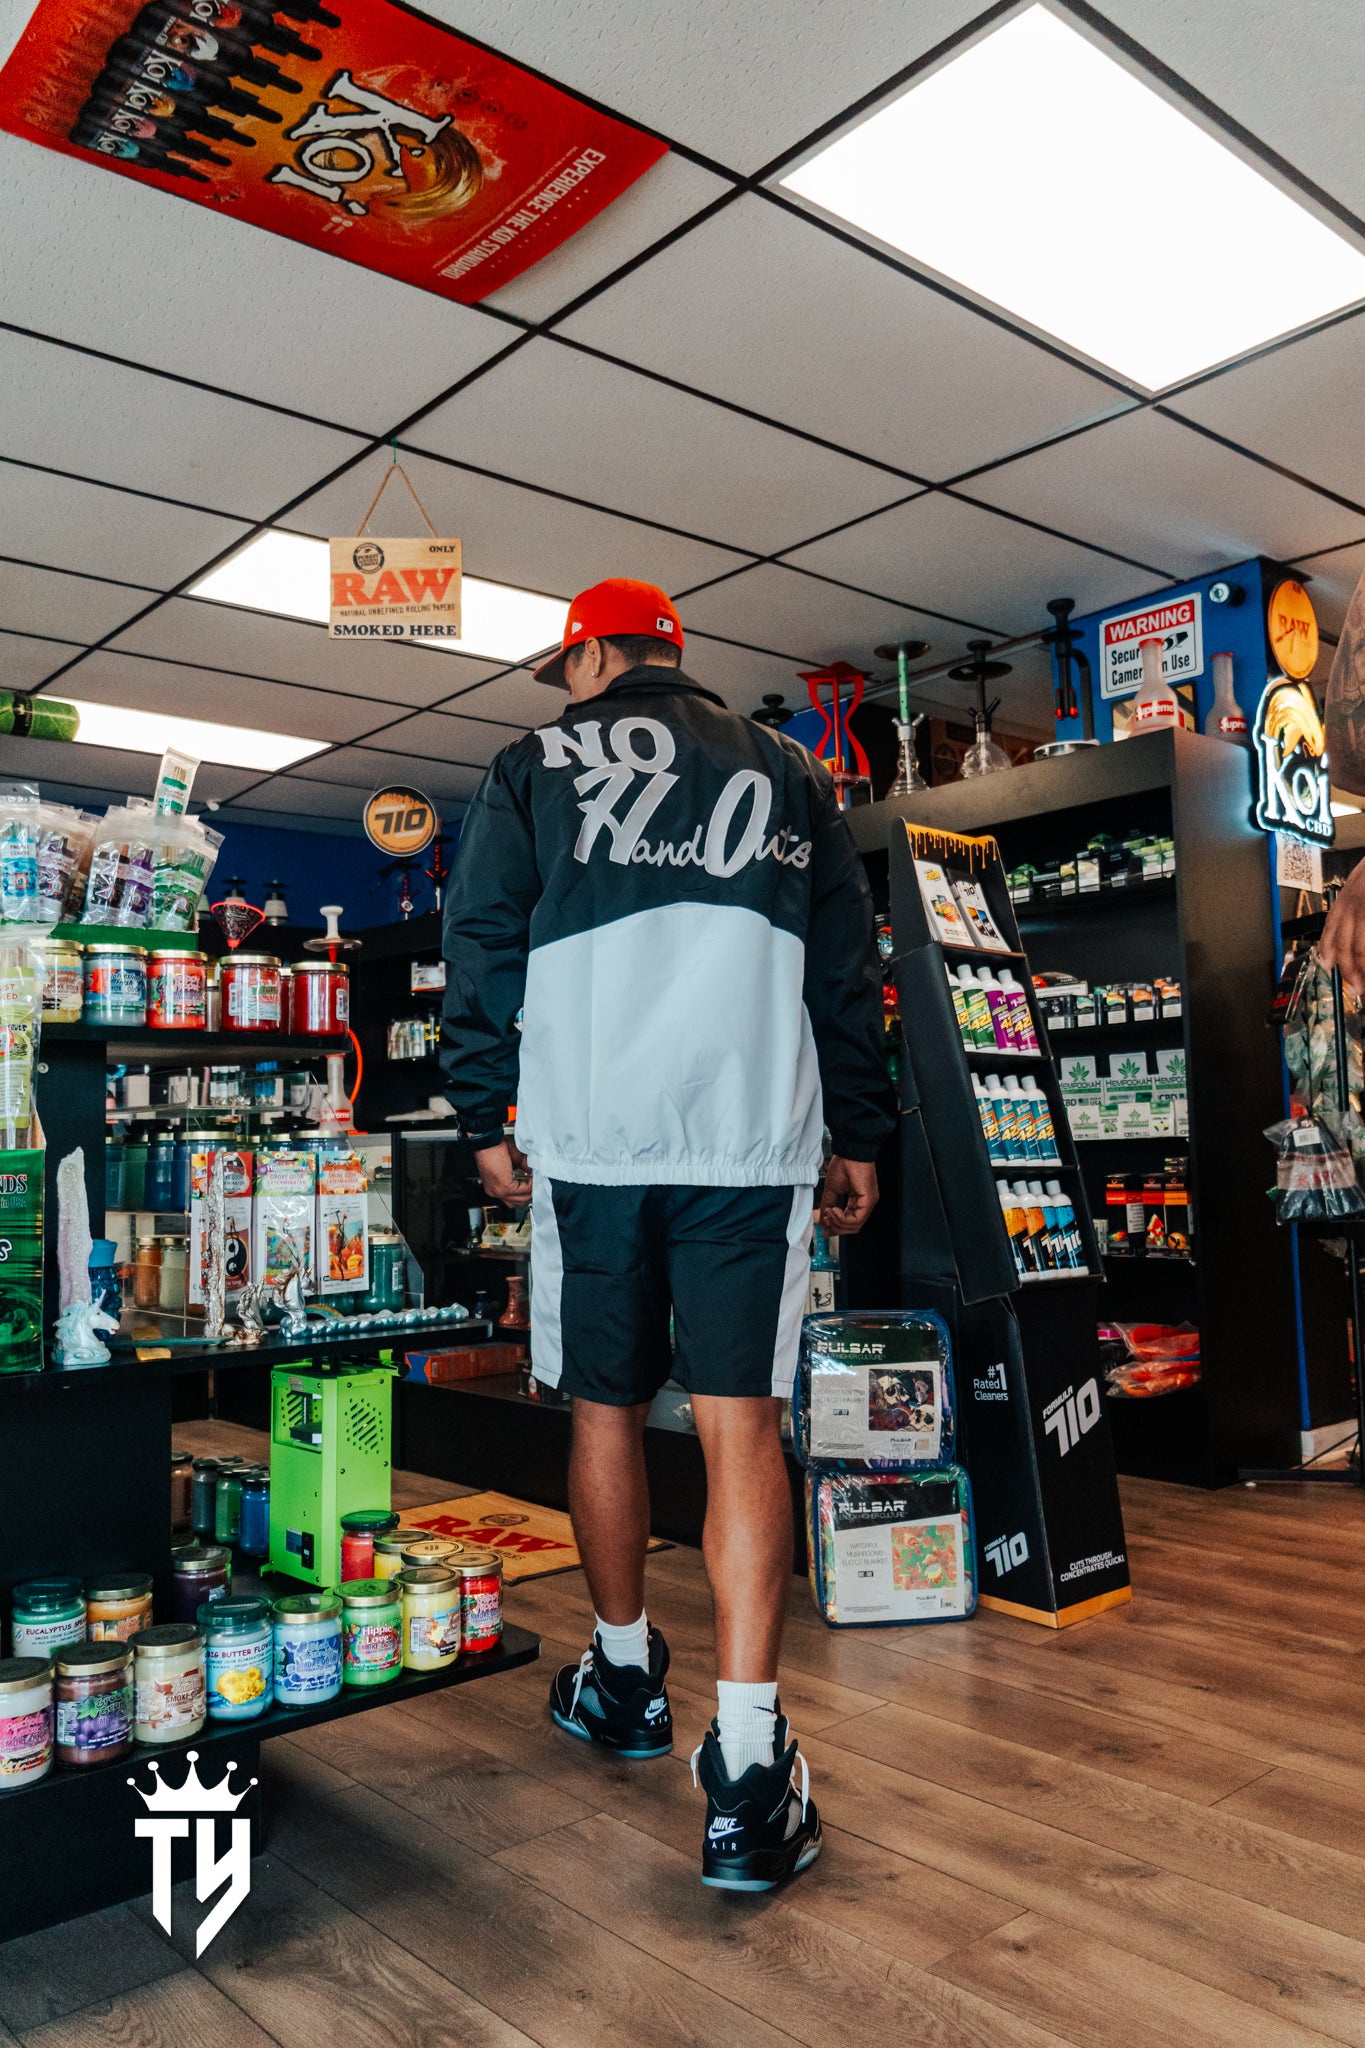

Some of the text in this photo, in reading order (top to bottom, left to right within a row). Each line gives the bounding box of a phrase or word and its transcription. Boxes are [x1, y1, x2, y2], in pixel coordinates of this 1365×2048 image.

[527, 148, 607, 213] EXPERIENCE
[506, 208, 541, 232] THE
[488, 225, 520, 245] KOI
[429, 545, 456, 553] ONLY
[331, 568, 457, 606] RAW
[340, 603, 456, 617] NATURAL UNREFINED ROLLING PAPERS
[333, 624, 457, 636] SMOKED HERE
[1110, 604, 1191, 642] WARNING
[1278, 614, 1310, 641] RAW
[1111, 648, 1140, 667] Secur
[1171, 654, 1190, 670] Use
[1220, 716, 1246, 732] Supre
[535, 717, 676, 774] NO
[1260, 734, 1332, 829] Koi
[375, 808, 428, 835] 710
[1306, 819, 1332, 837] CBD
[816, 1341, 884, 1354] PULSAR
[973, 1379, 1000, 1390] Rated
[974, 1391, 1009, 1401] Cleaners
[1044, 1377, 1101, 1458] 710
[839, 1500, 906, 1513] PULSAR
[409, 1515, 574, 1553] RAW
[985, 1531, 1029, 1578] 710
[1069, 1551, 1112, 1571] CUTS THROUGH
[1060, 1554, 1125, 1582] CONCENTRATES QUICK!
[26, 1625, 72, 1636] EUCALYPTUS
[362, 1623, 393, 1637] Hippie
[366, 1635, 391, 1645] Love
[206, 1641, 273, 1659] BIG BUTTER FLOW
[165, 1693, 189, 1704] SMOKE
[649, 1697, 668, 1710] NIKE
[650, 1715, 668, 1726] AIR
[712, 1816, 737, 1830] NIKE
[711, 1841, 737, 1851] AIR
